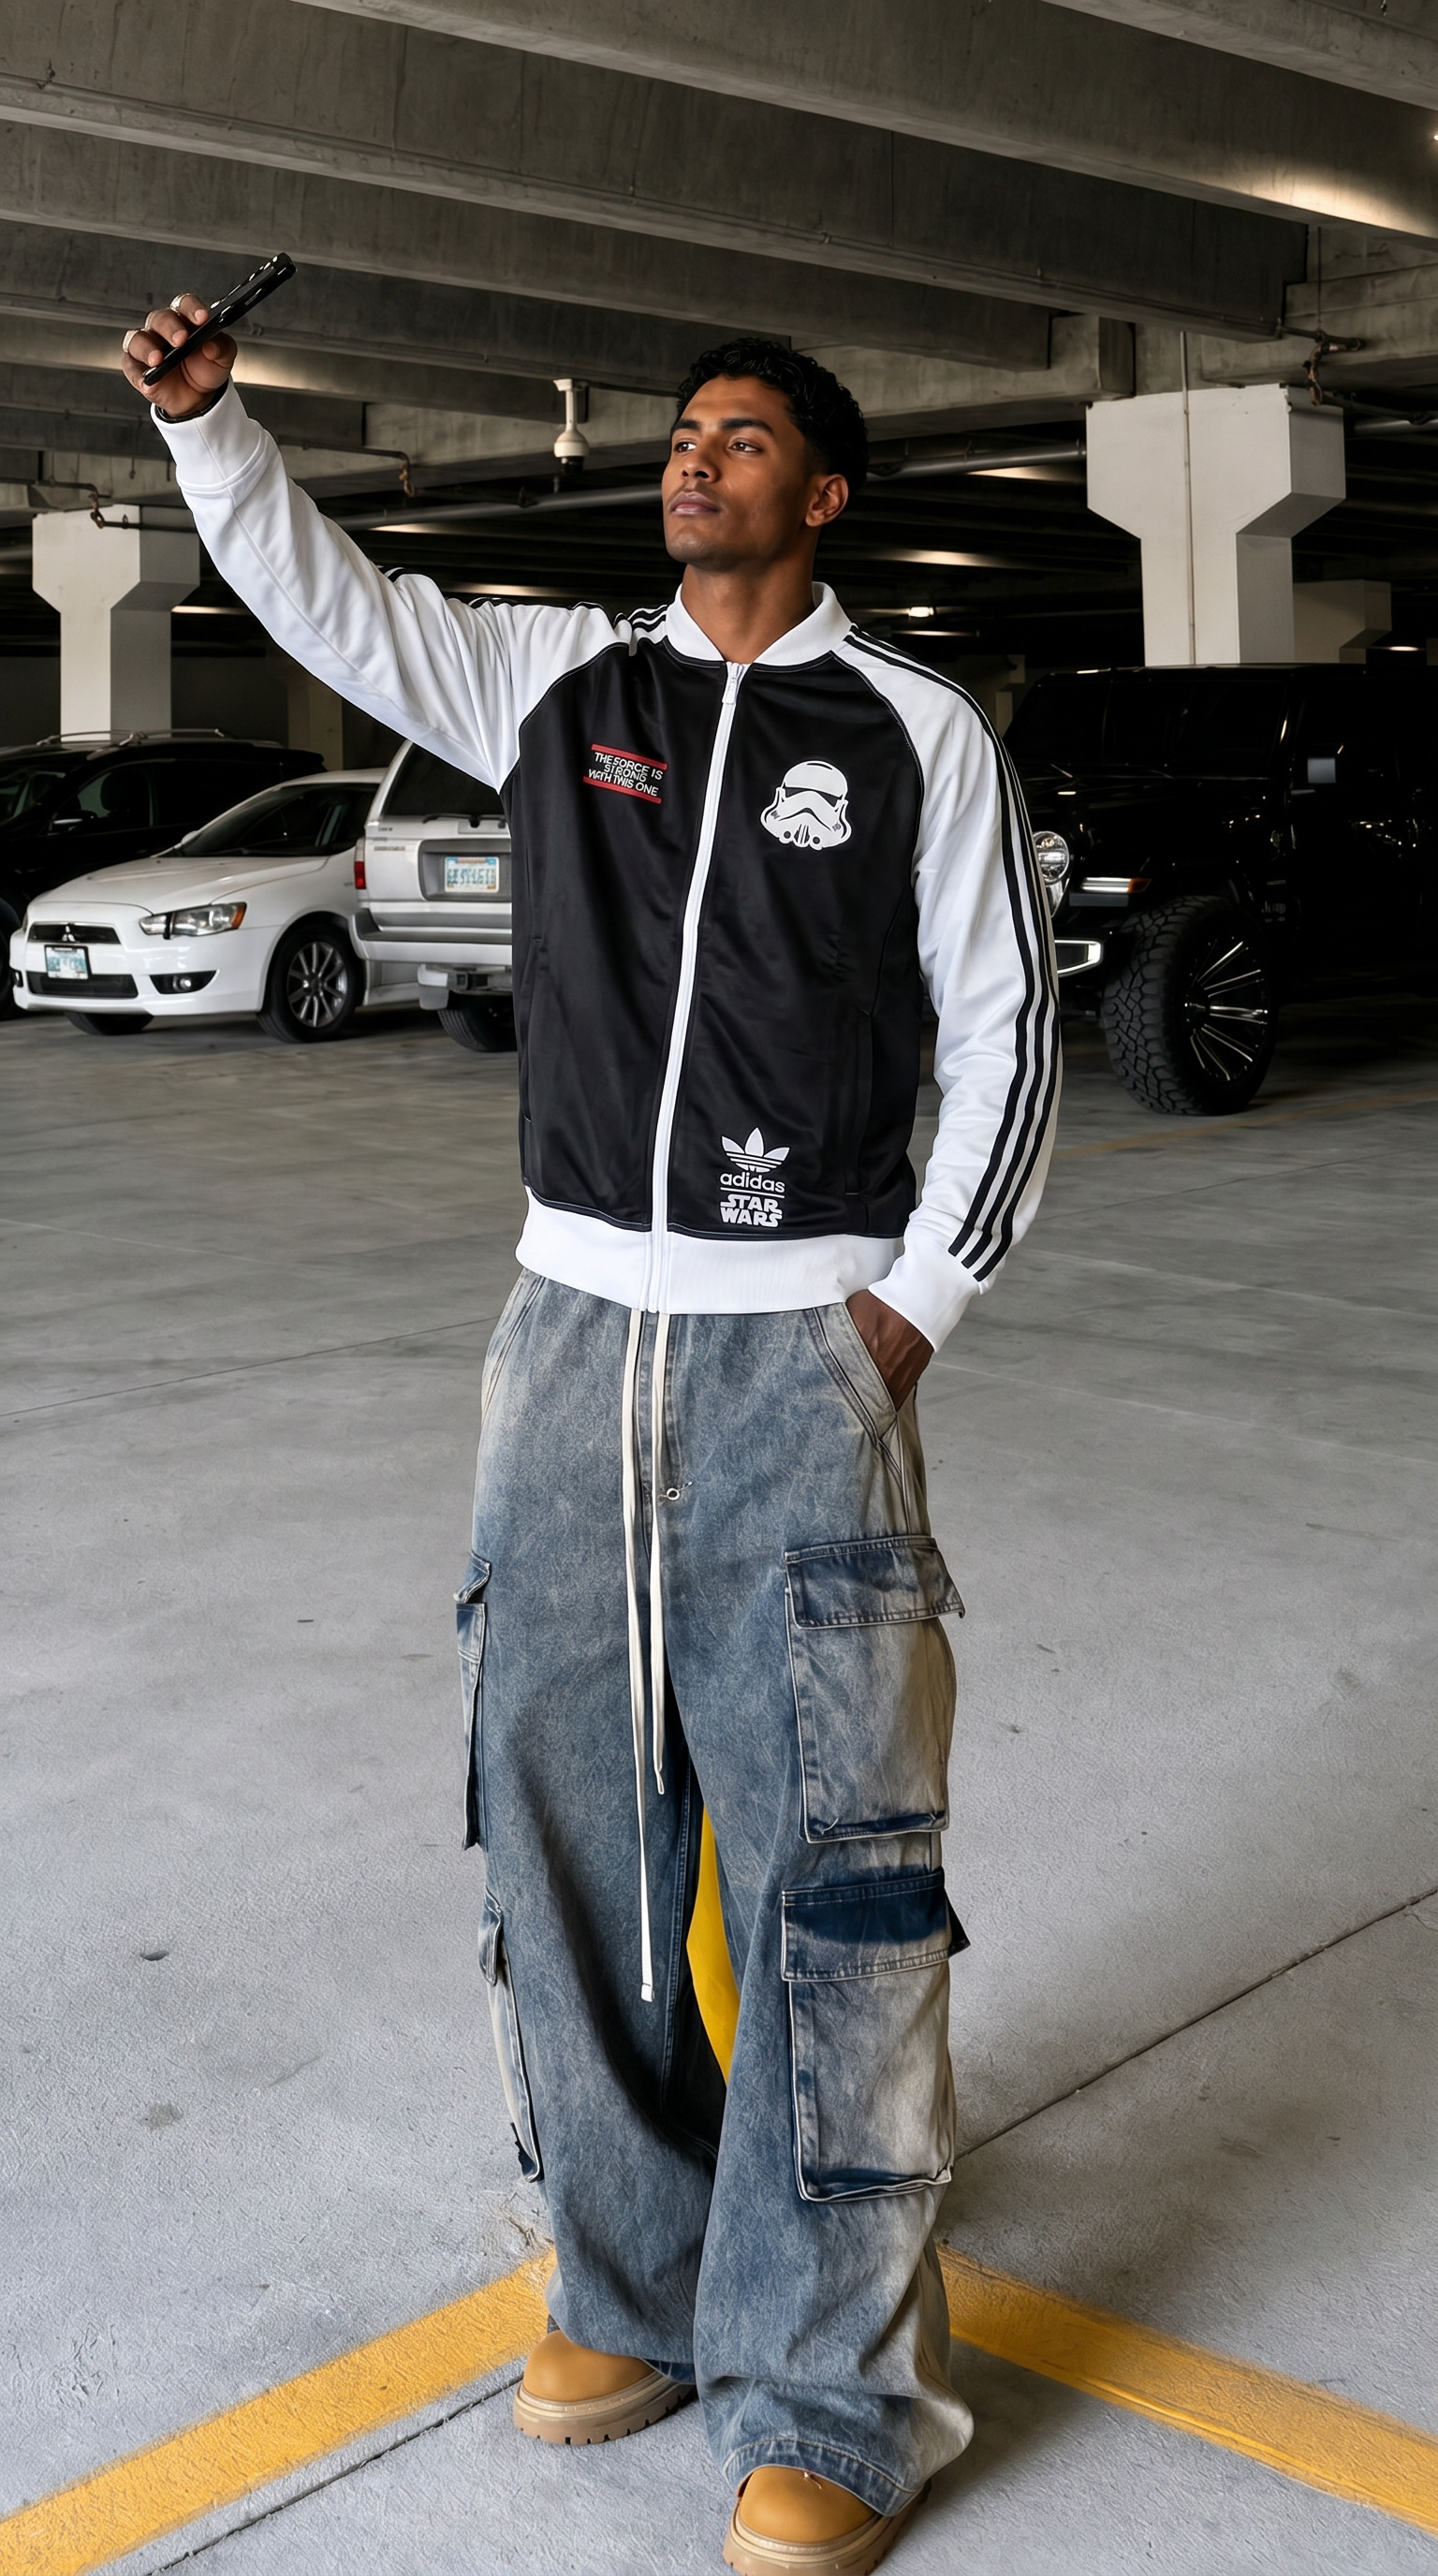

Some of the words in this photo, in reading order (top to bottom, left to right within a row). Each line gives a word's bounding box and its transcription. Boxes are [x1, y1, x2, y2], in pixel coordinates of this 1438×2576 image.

[594, 752, 614, 765] THE
[651, 768, 664, 780] IS
[635, 782, 659, 797] ONE
[720, 1172, 785, 1193] adidas
[720, 1193, 783, 1215] STAR
[720, 1207, 783, 1228] WARS
